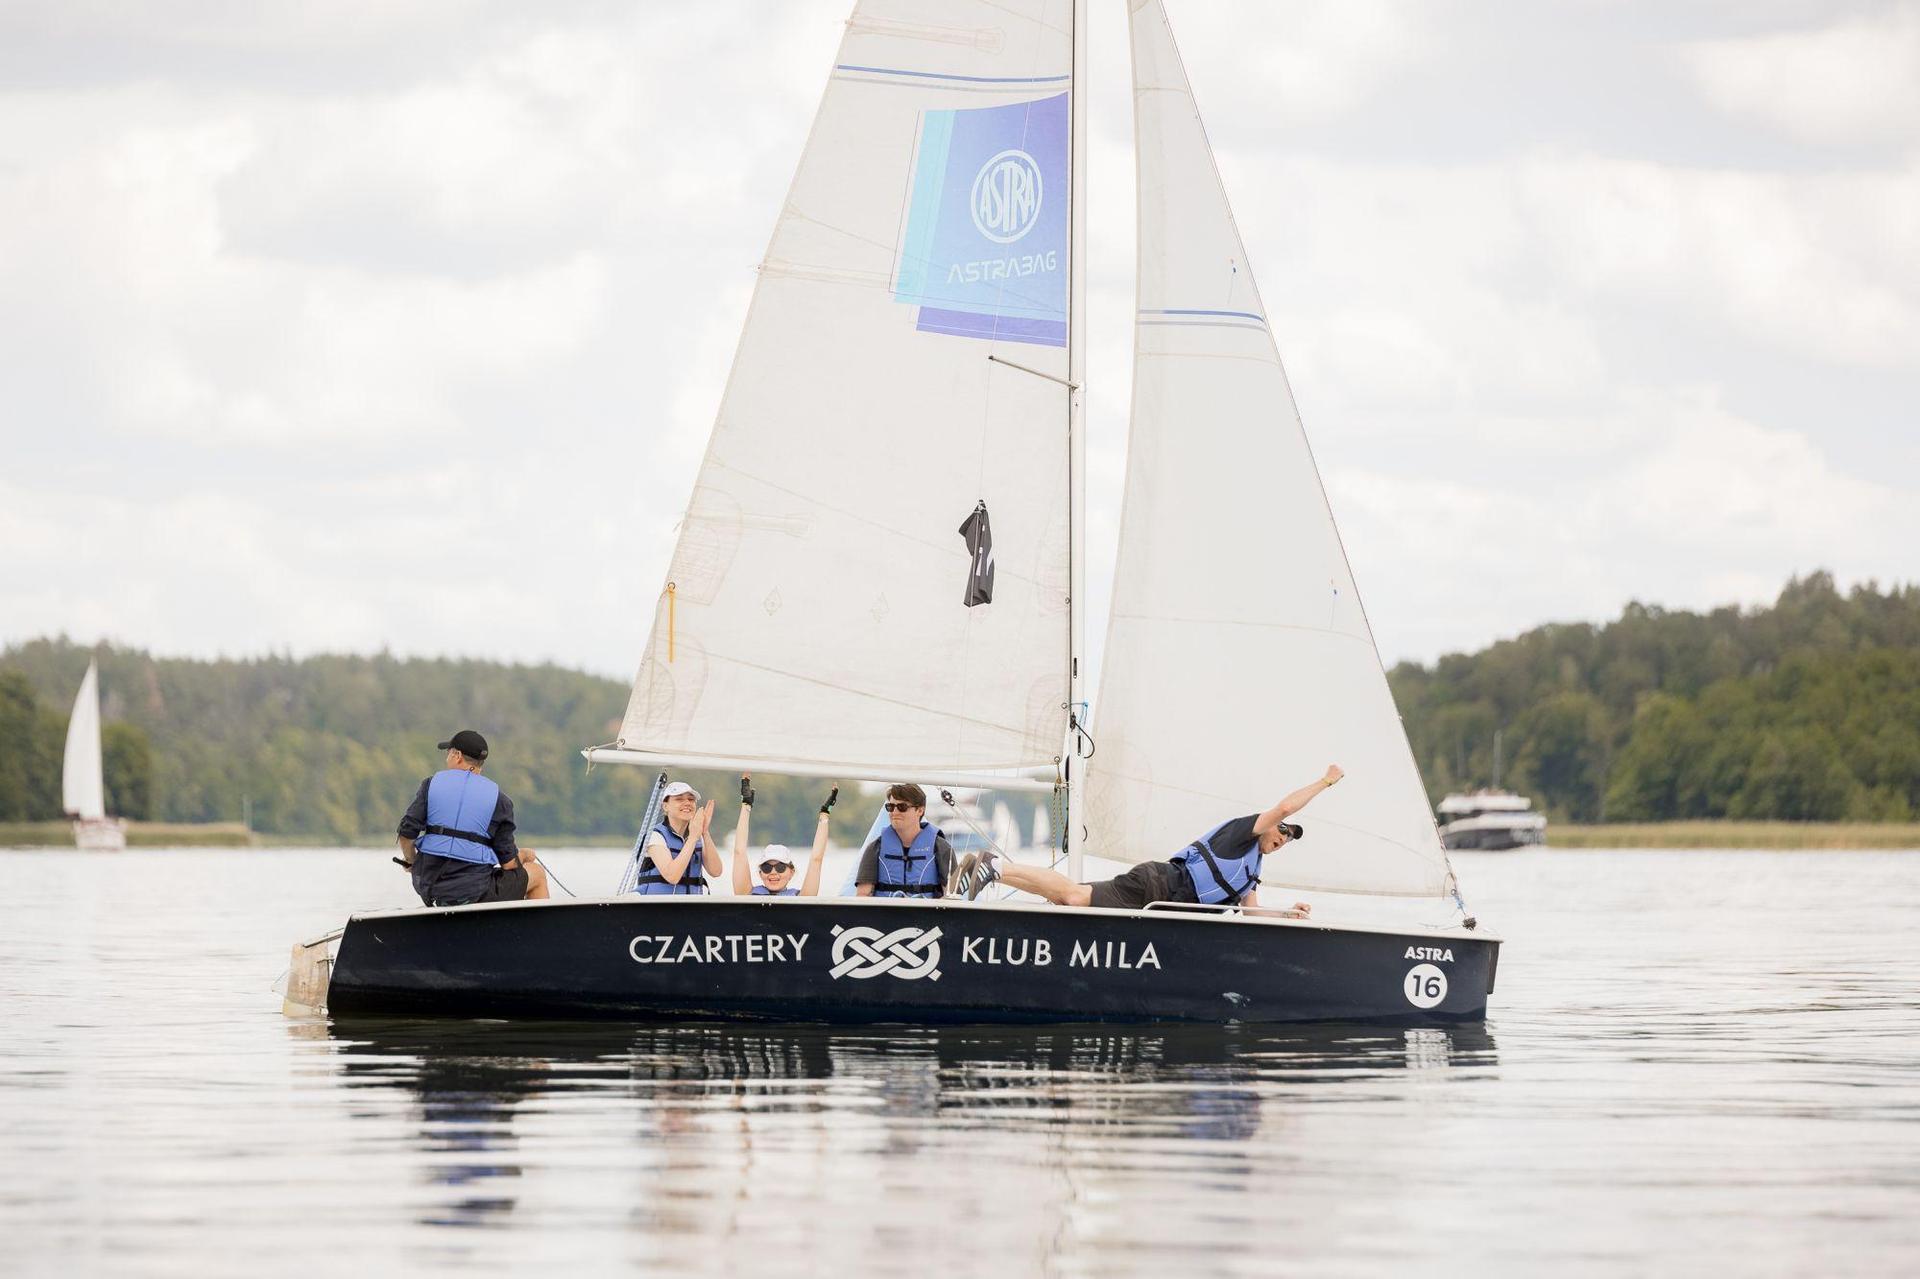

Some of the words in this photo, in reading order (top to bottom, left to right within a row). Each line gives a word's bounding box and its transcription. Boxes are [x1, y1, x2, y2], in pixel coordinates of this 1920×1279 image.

[980, 159, 1036, 233] ASTRA
[947, 250, 1056, 284] ASTRABAG
[628, 934, 809, 963] CZARTERY
[961, 936, 1052, 966] KLUB
[1069, 940, 1162, 970] MILA
[1404, 946, 1455, 963] ASTRA
[1413, 974, 1441, 998] 16
